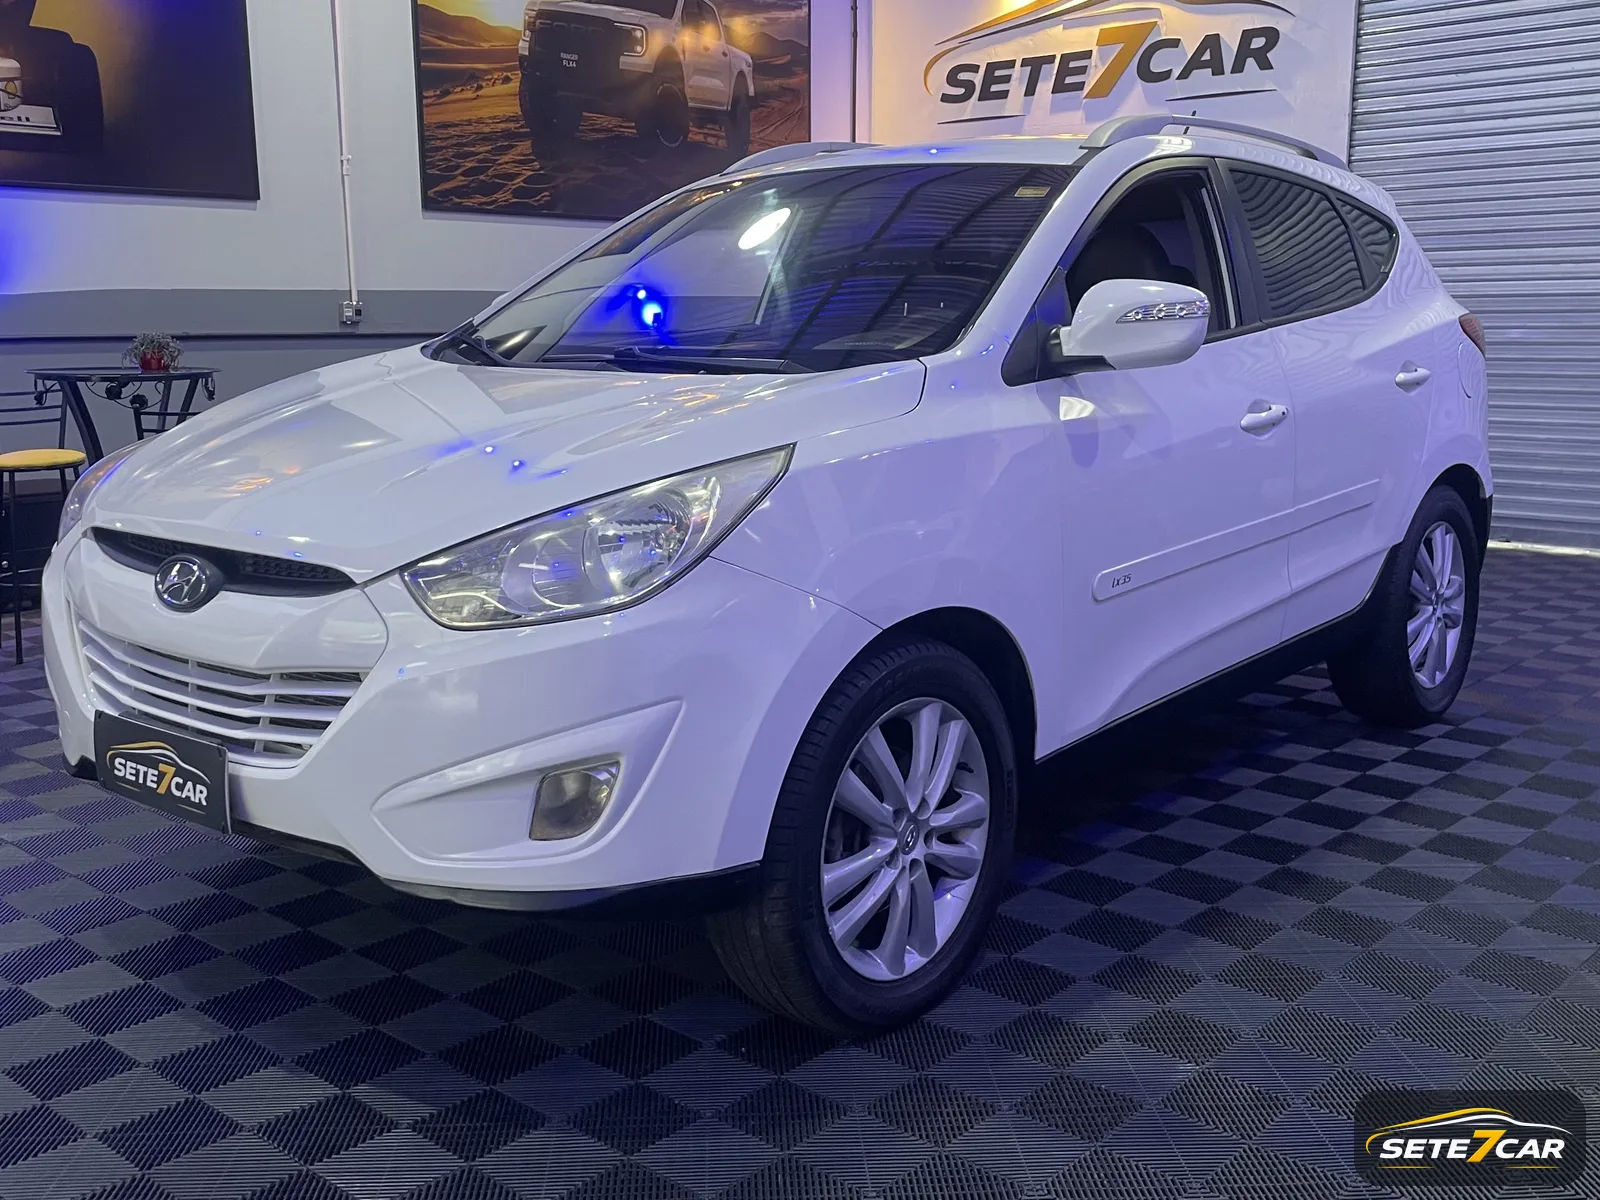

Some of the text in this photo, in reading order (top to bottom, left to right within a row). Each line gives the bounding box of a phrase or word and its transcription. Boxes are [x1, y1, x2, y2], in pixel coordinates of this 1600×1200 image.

[560, 52, 579, 61] RANGER
[940, 21, 1280, 103] SETE7CAR
[114, 757, 208, 806] SETE7CAR
